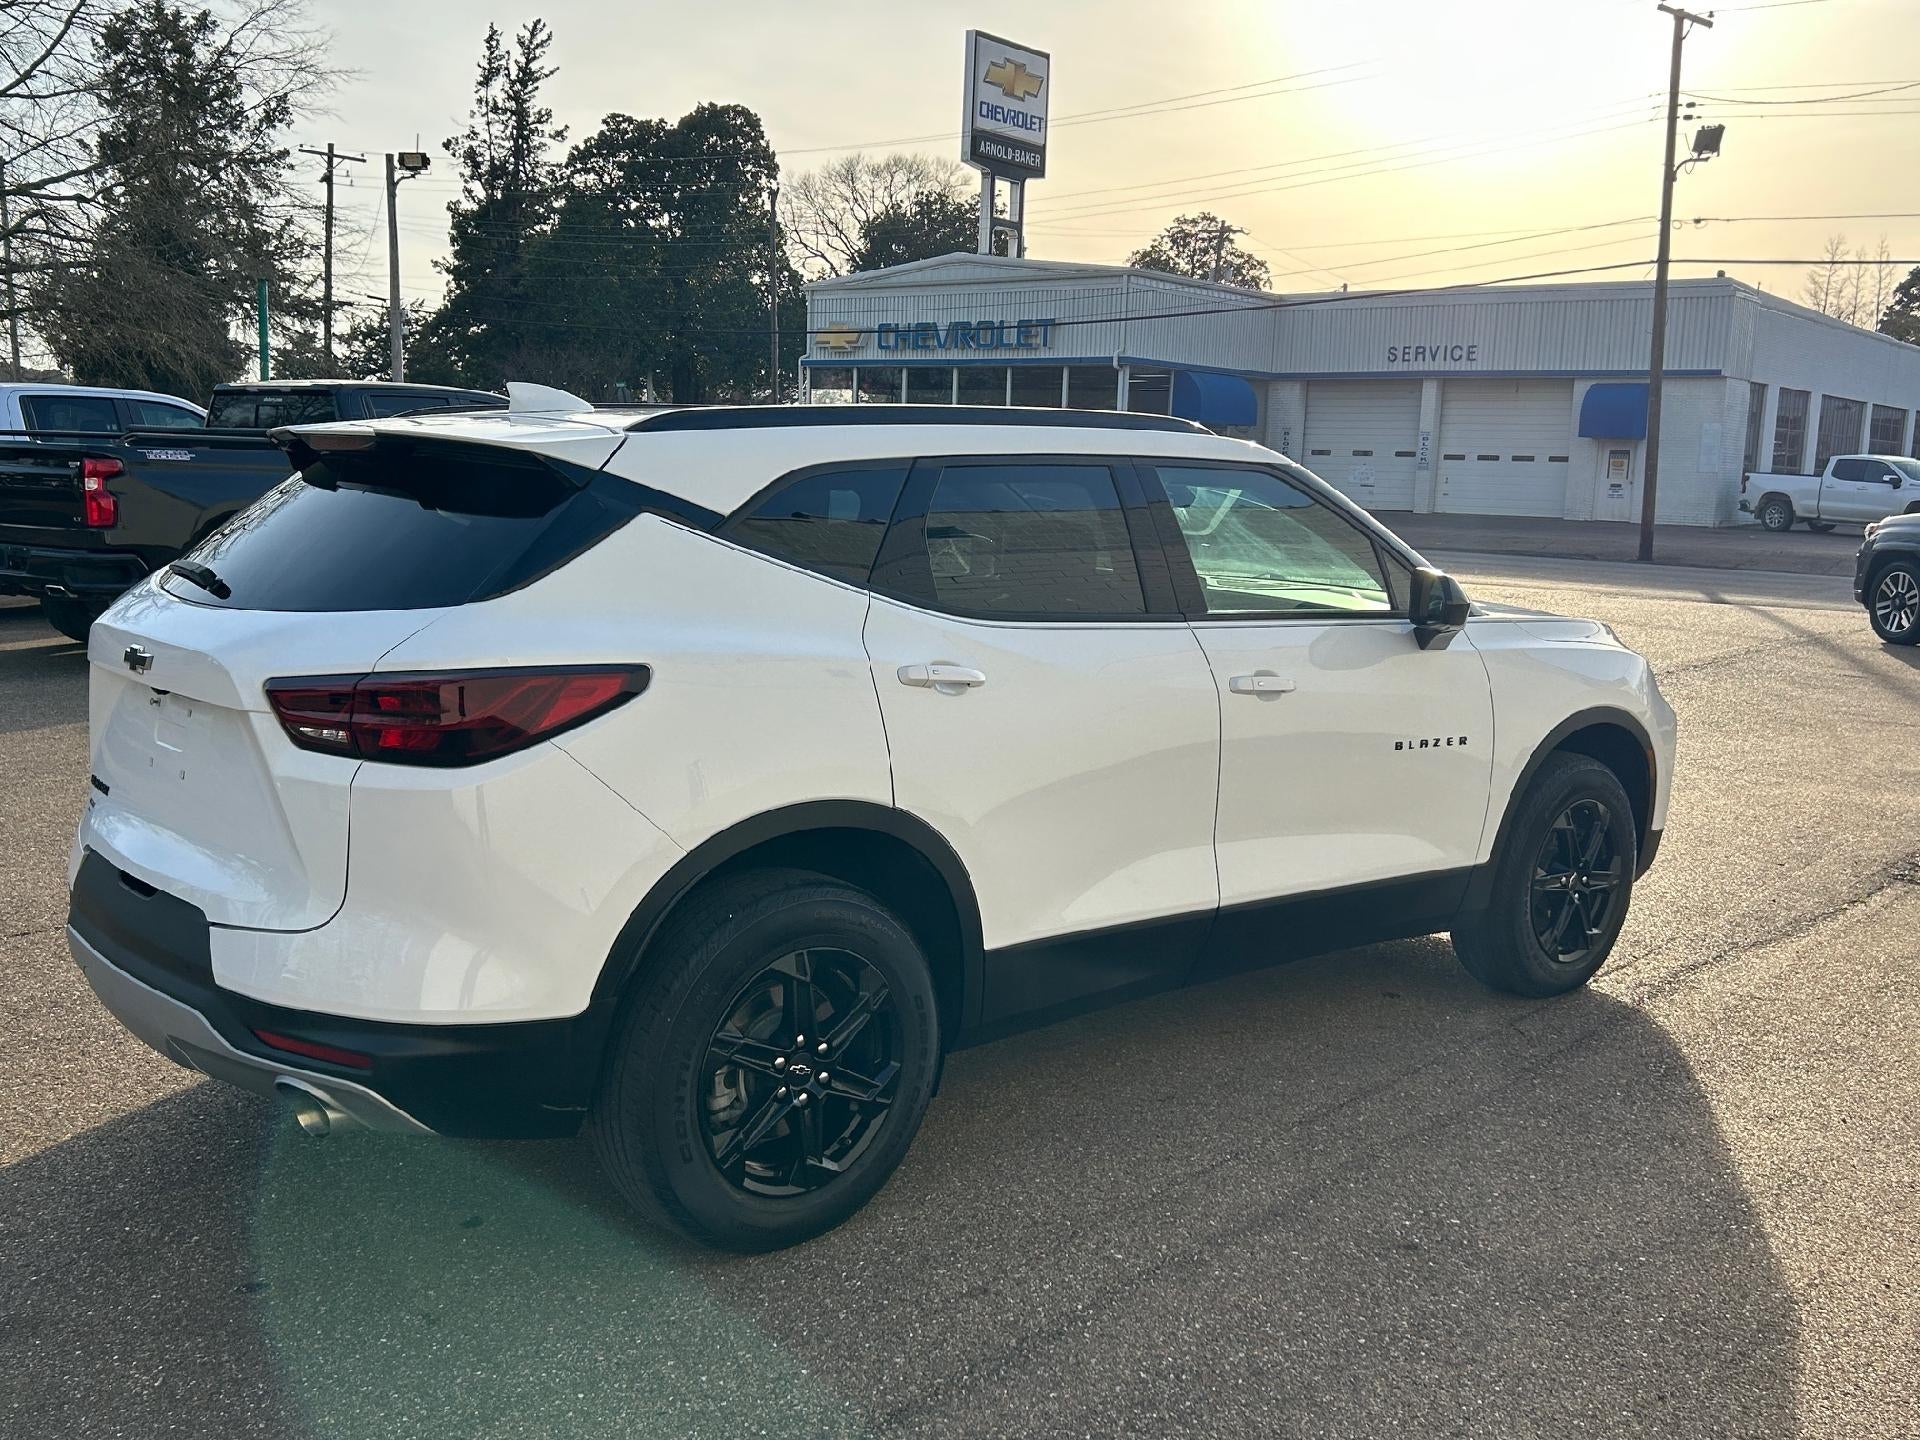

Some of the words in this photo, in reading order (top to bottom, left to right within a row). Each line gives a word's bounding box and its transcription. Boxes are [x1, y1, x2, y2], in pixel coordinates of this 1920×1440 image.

[978, 100, 1044, 133] CHEVROLET
[979, 140, 1041, 167] ARNOLD-BAKER
[877, 318, 1056, 351] CHEVROLET
[1387, 344, 1478, 363] SERVICE
[1394, 736, 1468, 751] BLAZER
